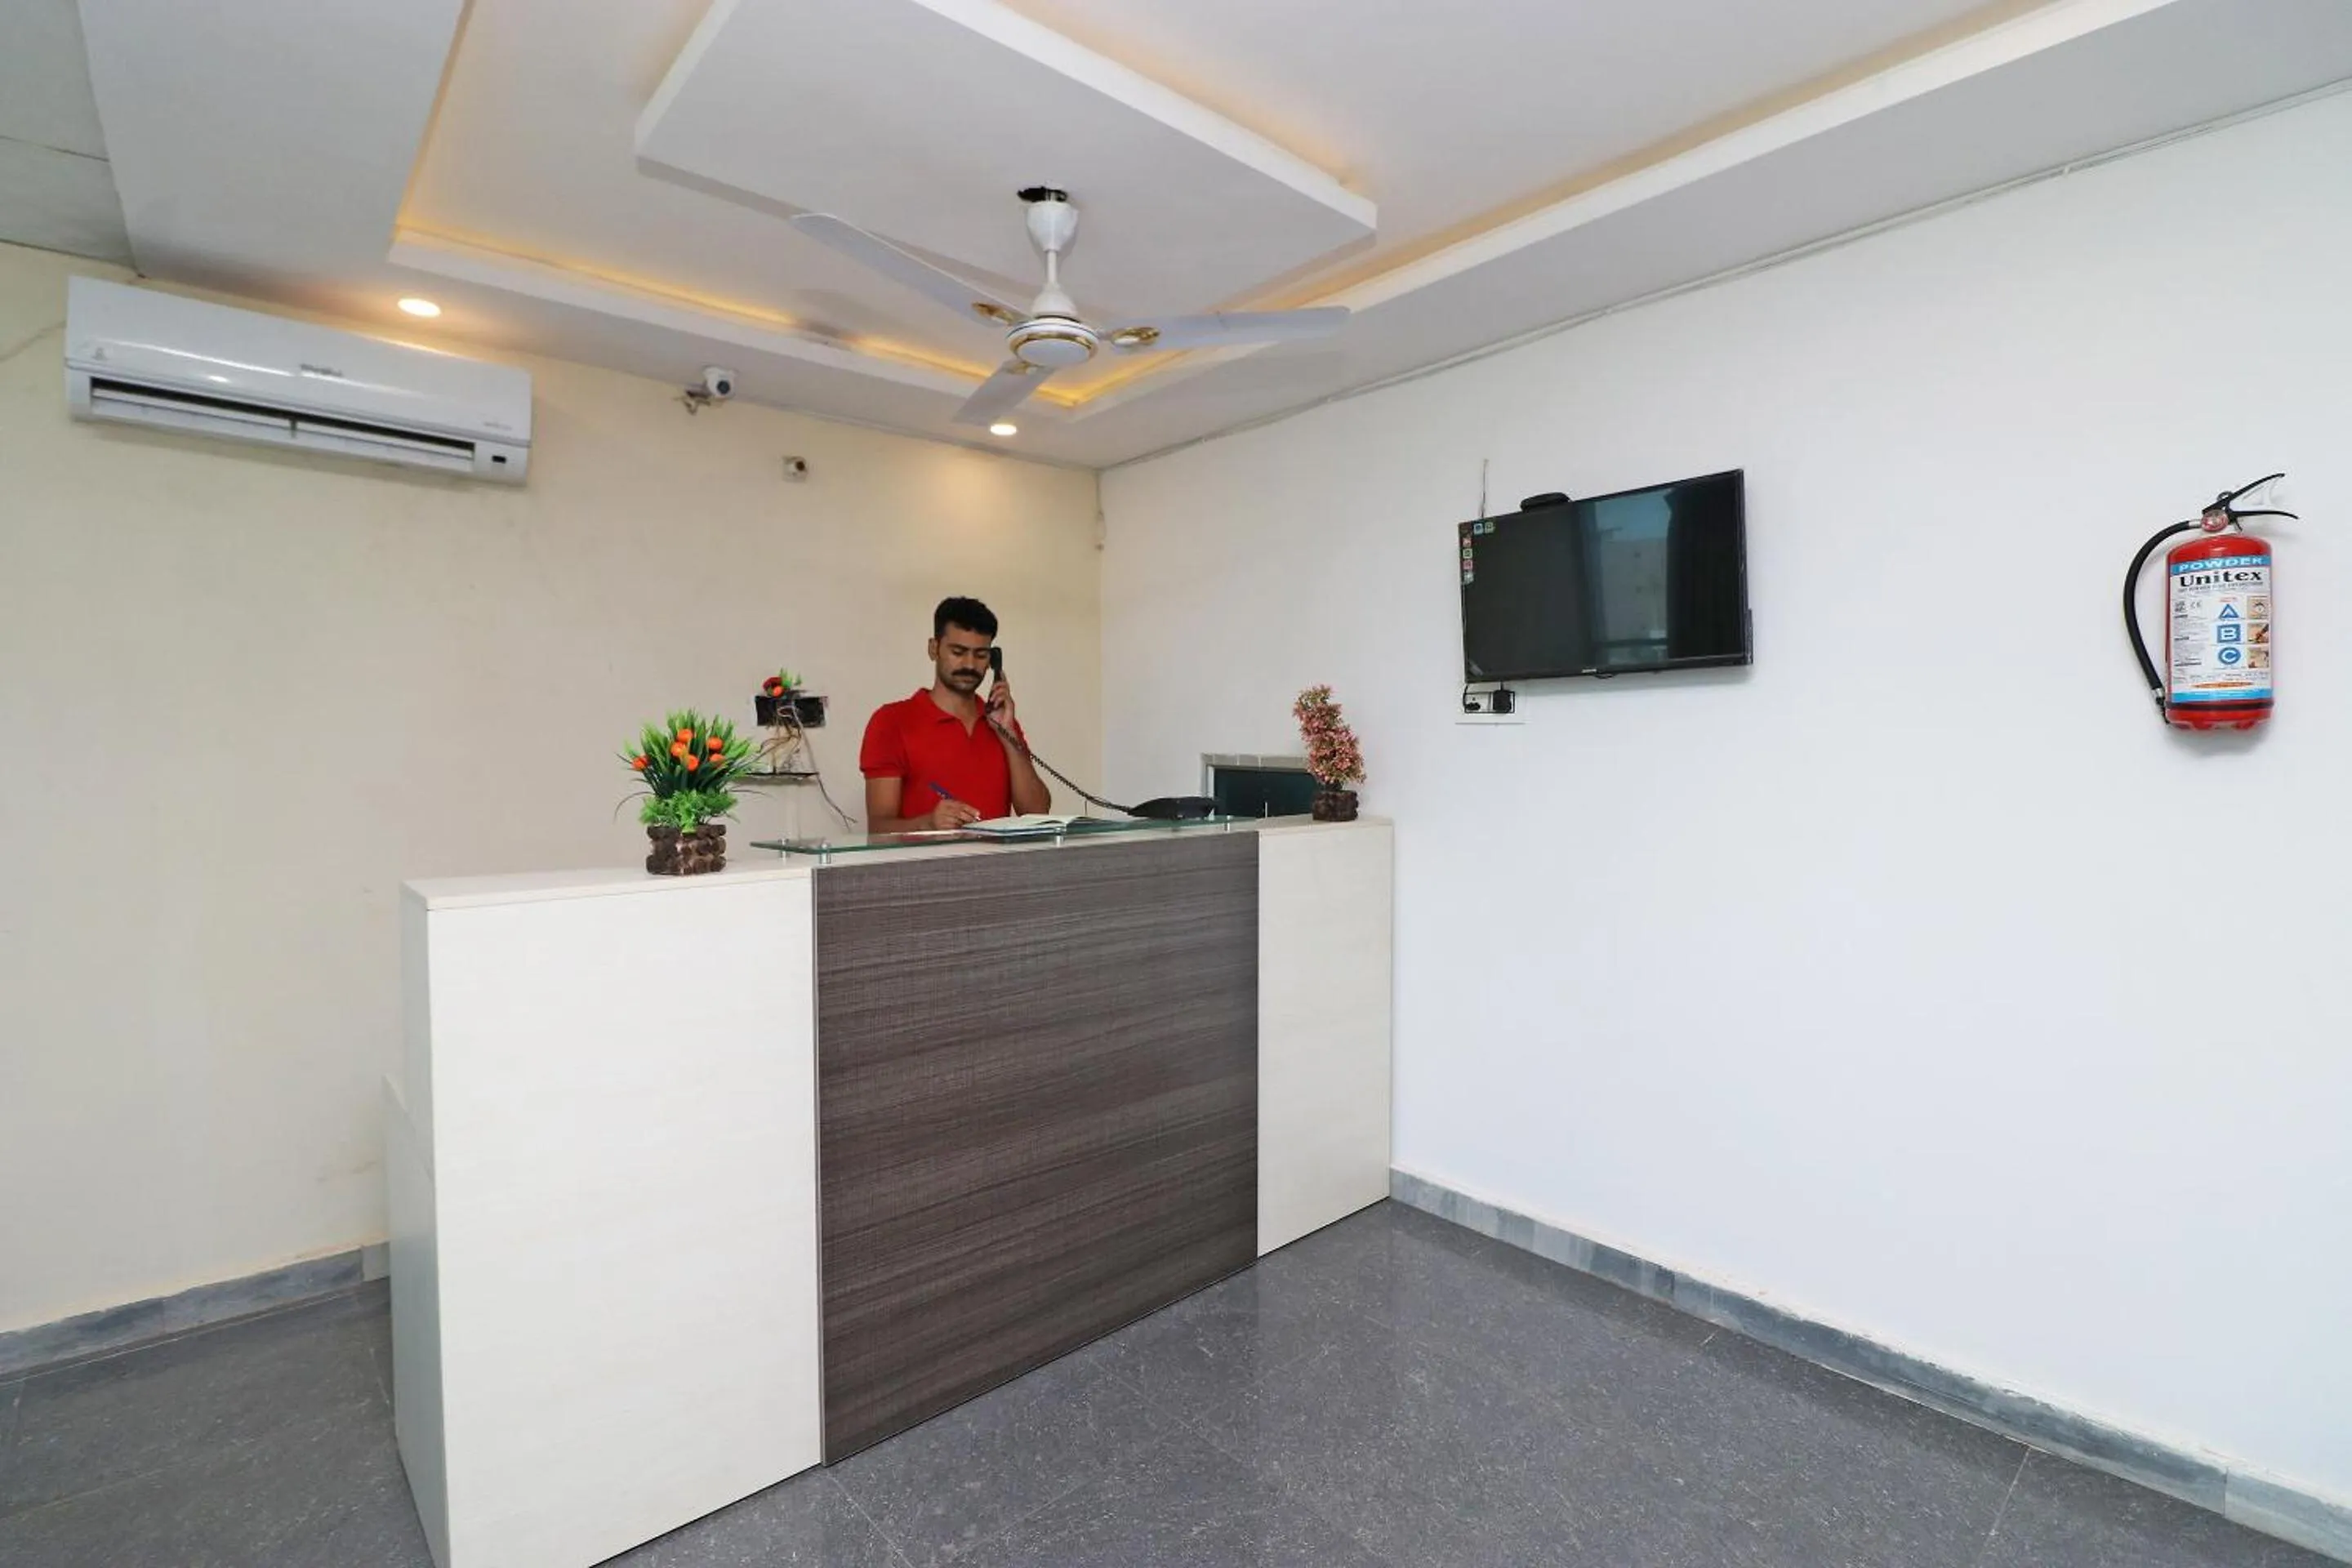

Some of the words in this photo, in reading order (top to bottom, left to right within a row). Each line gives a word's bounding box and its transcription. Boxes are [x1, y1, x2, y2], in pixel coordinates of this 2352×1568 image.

[2180, 571, 2262, 586] Unitex
[2221, 626, 2238, 641] B
[2221, 648, 2239, 663] C
